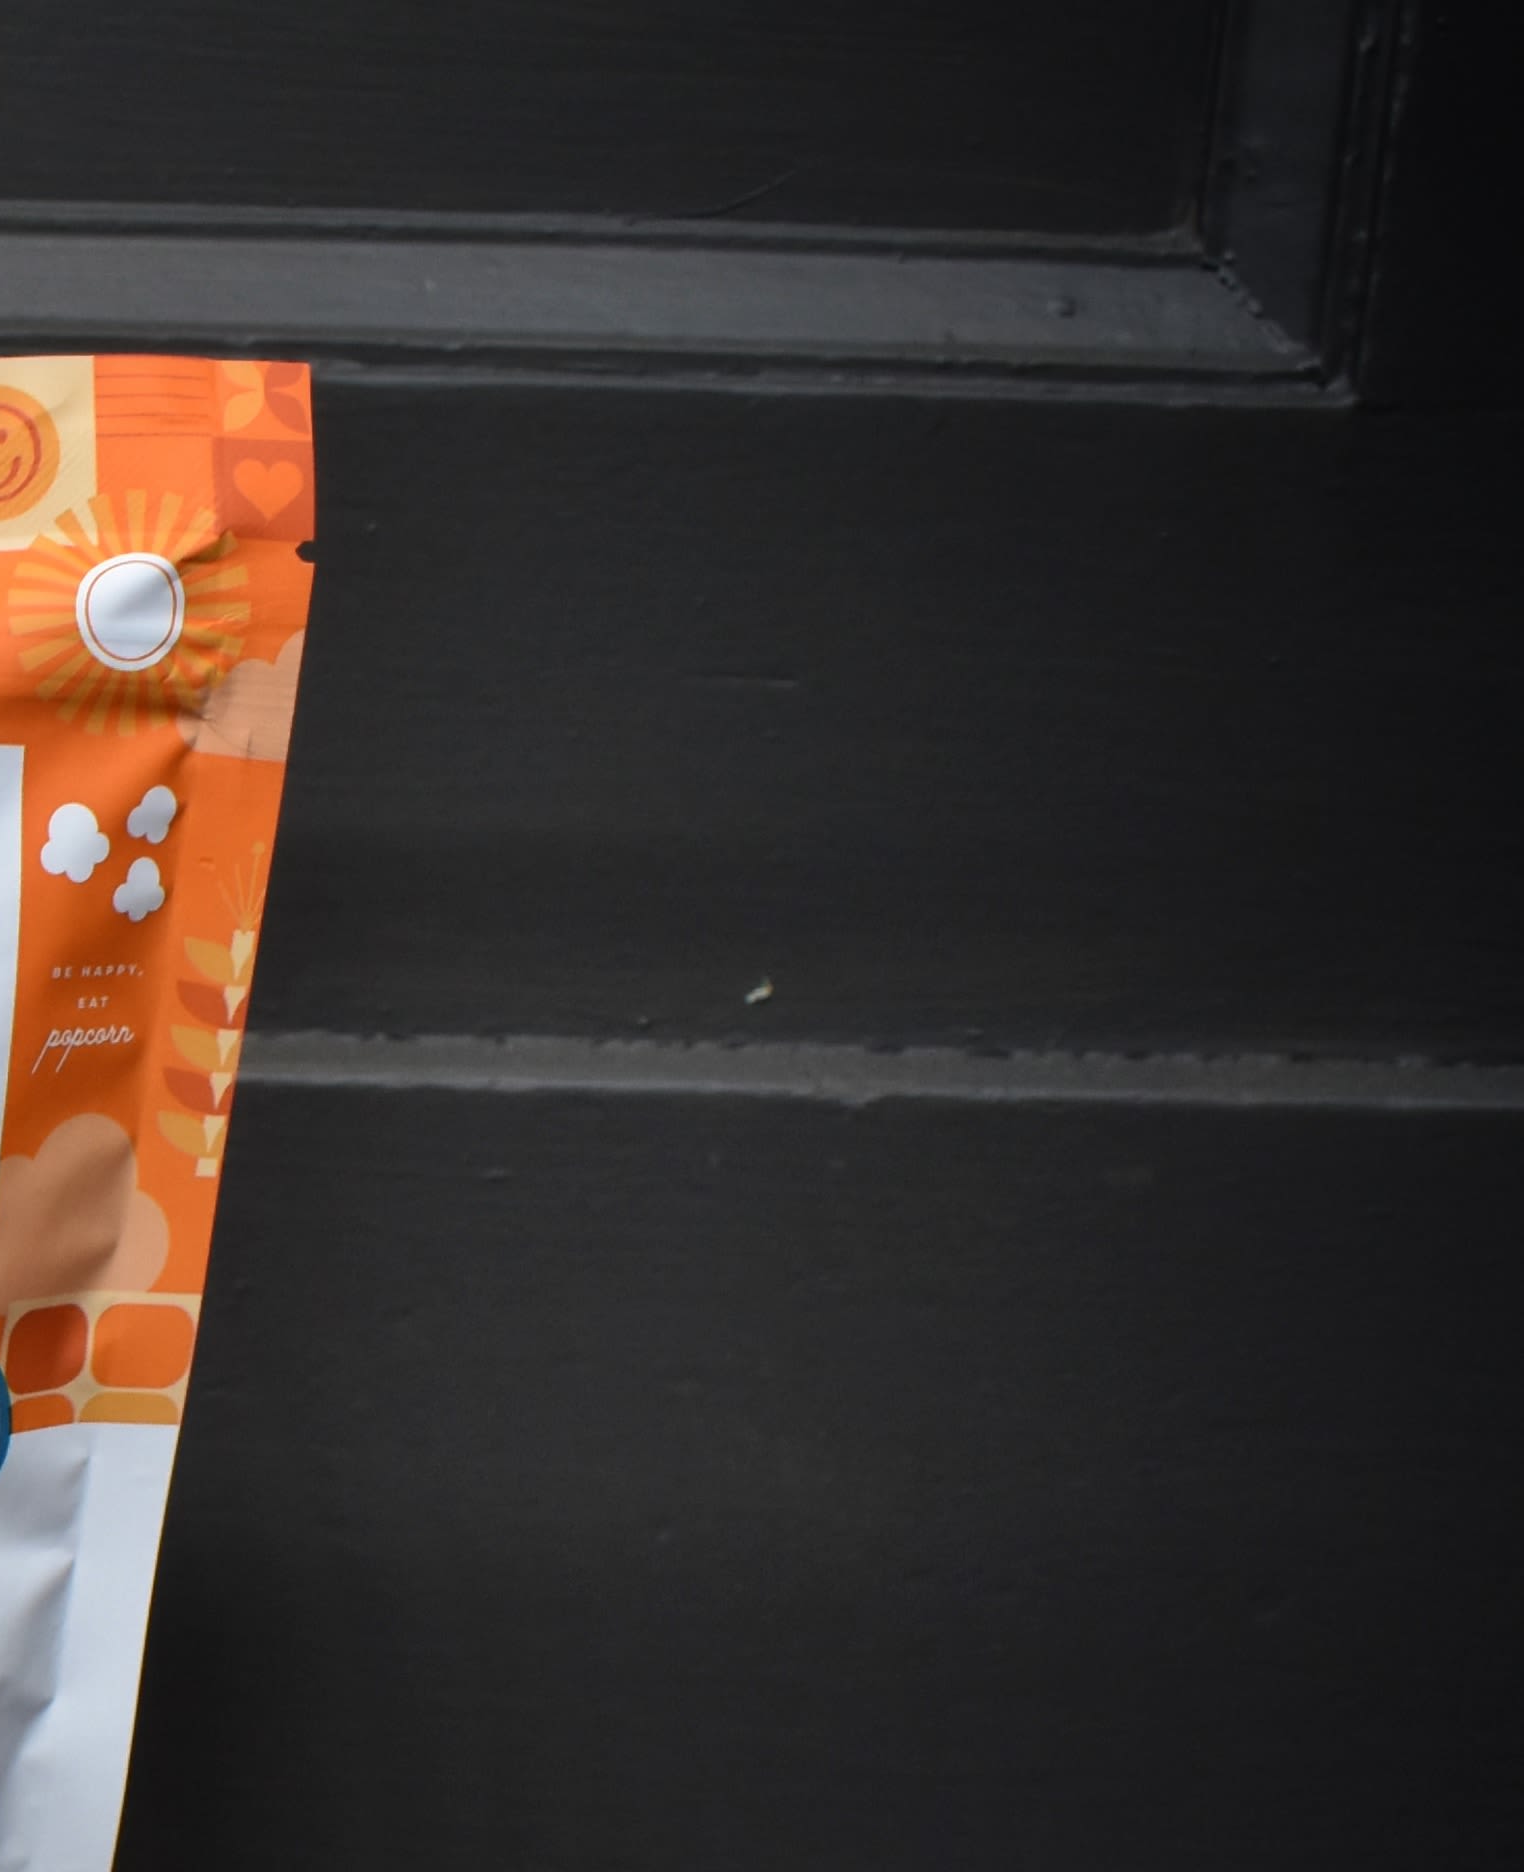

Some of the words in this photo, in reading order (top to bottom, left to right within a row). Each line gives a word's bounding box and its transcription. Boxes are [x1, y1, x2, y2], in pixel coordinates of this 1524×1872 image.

[51, 966, 73, 980] BE
[81, 963, 145, 979] HAPPY,
[77, 996, 110, 1010] EAT
[31, 1024, 135, 1075] popcorn
